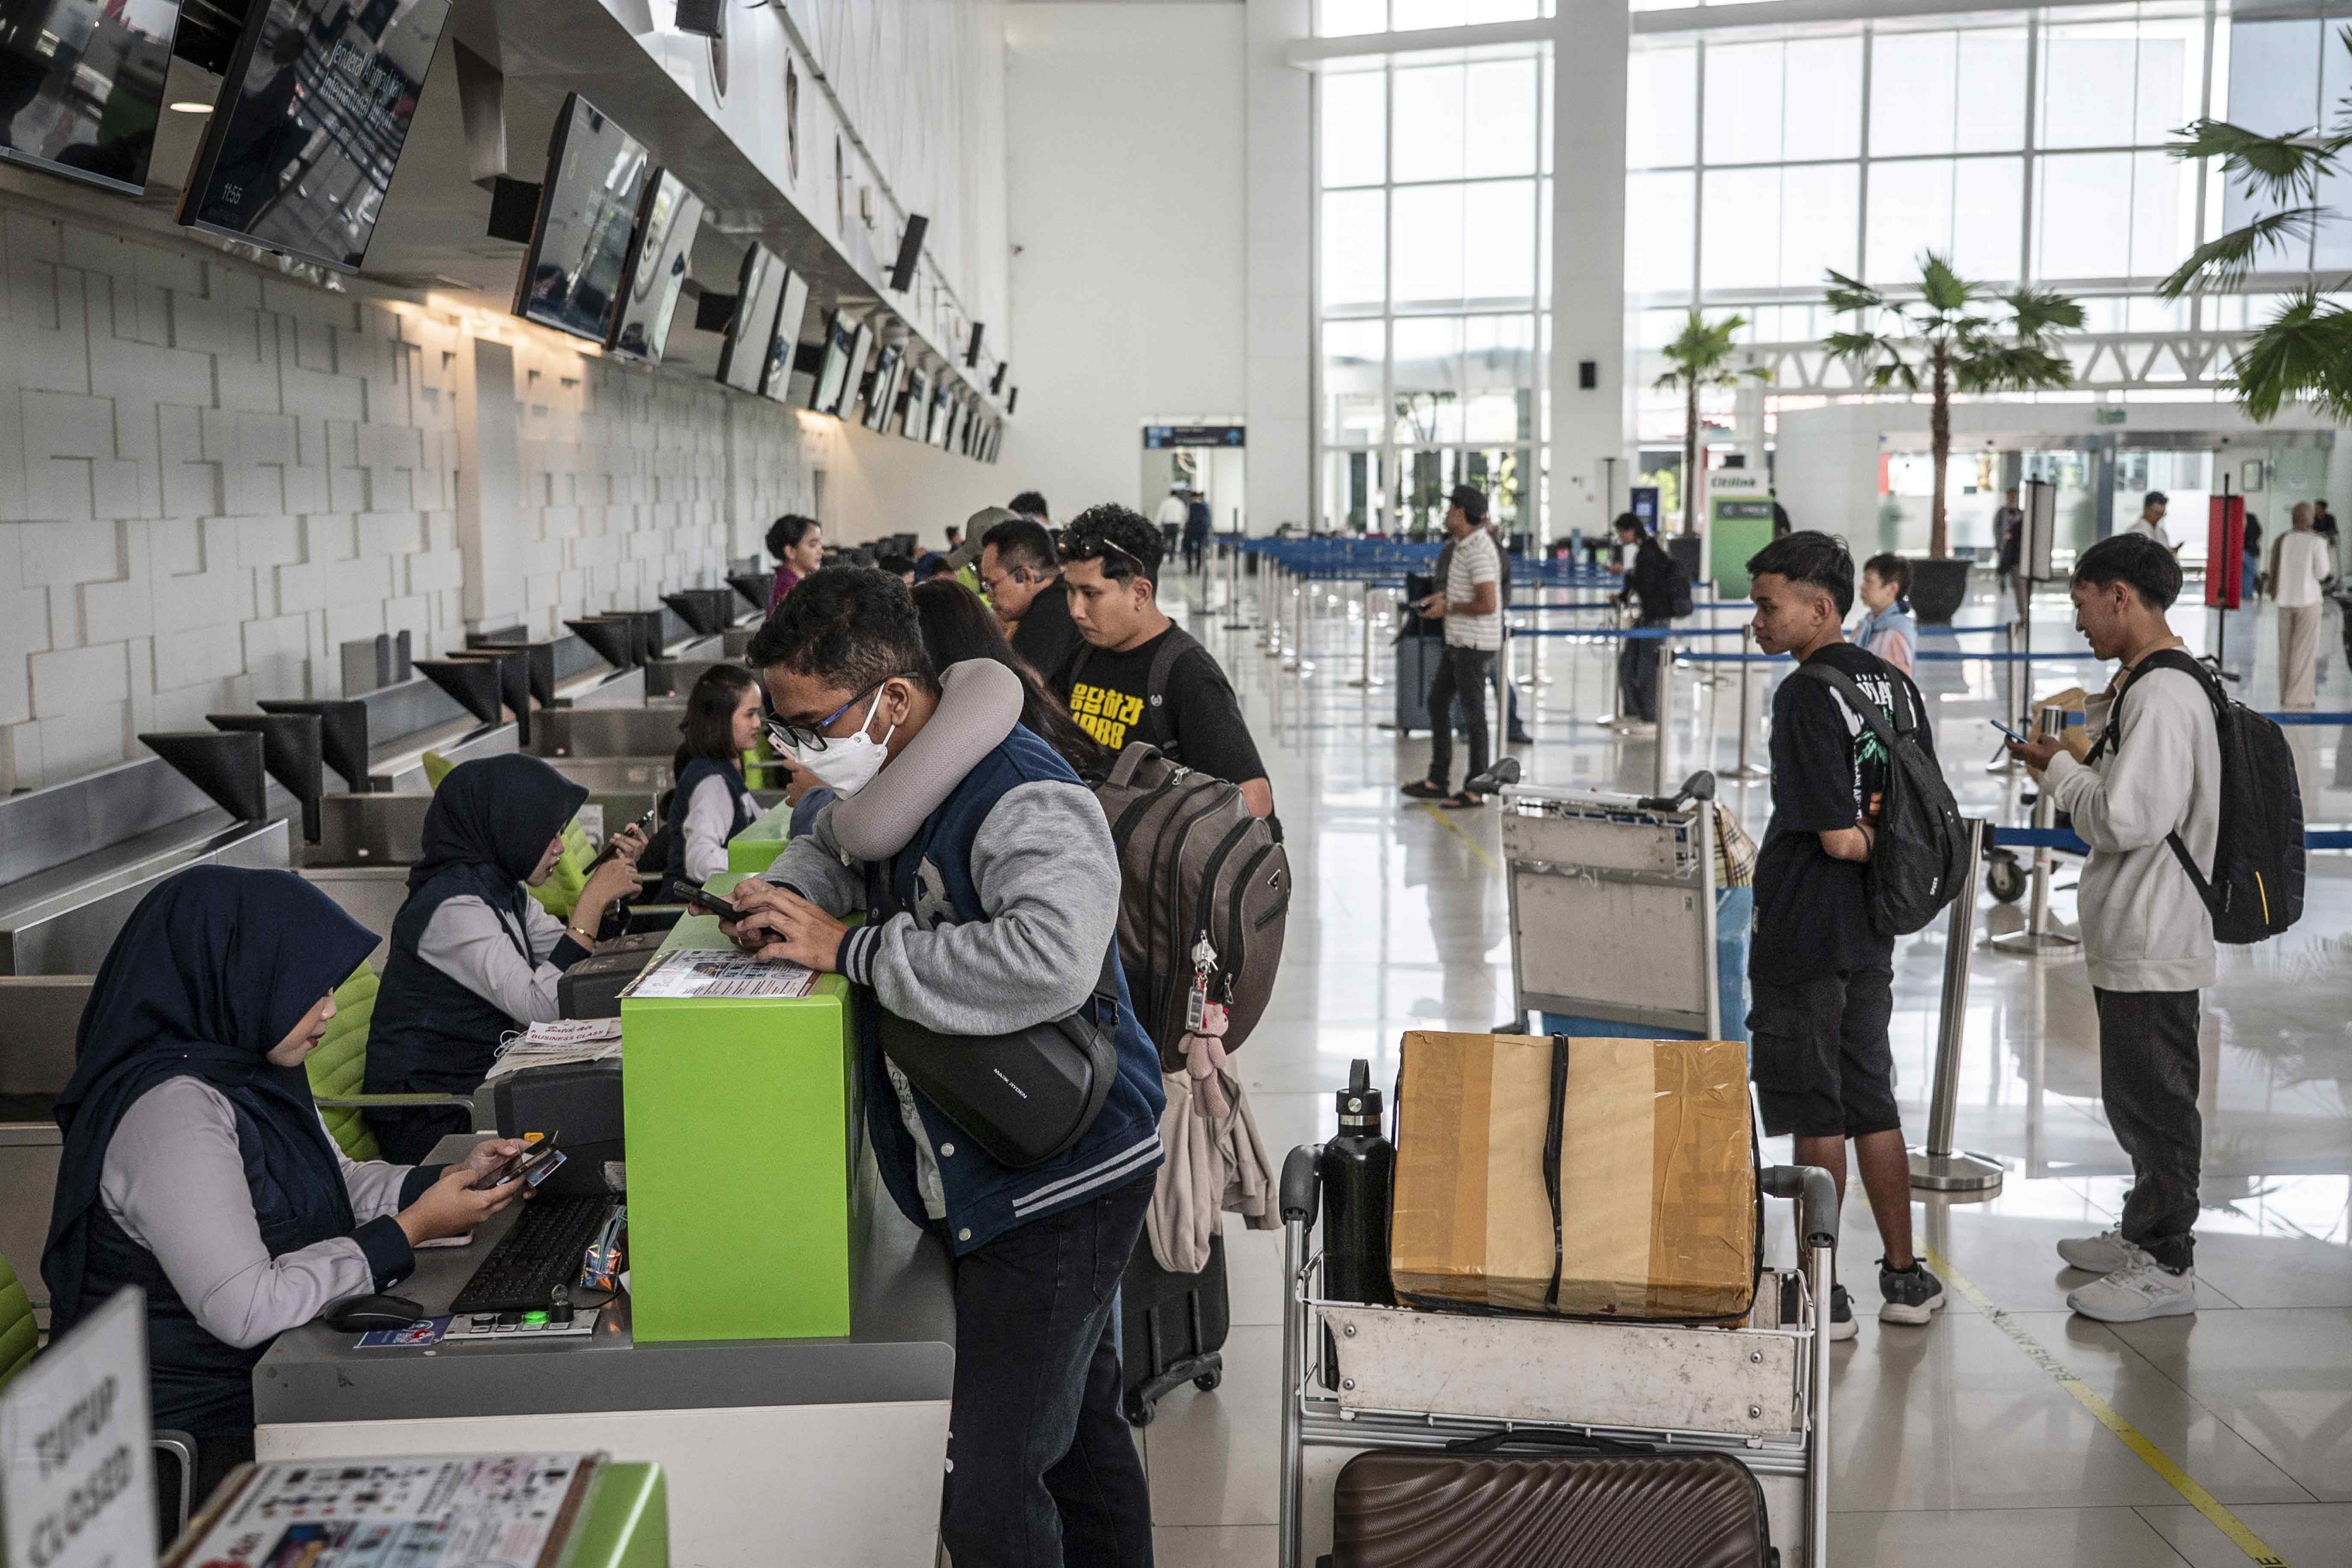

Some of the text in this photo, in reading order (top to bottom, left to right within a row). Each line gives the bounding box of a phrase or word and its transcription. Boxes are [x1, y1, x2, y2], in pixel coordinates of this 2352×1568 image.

[326, 39, 368, 77] Jenderal
[363, 58, 393, 93] Ahmad
[320, 72, 373, 118] International
[222, 183, 243, 204] 11:55
[1711, 477, 1756, 488] Citilink
[1070, 682, 1145, 726] 응답하라
[1072, 711, 1126, 750] 1988
[576, 1029, 604, 1039] CLASS
[993, 1068, 1028, 1099] MARK RYDEN
[28, 1445, 133, 1568] CLOSED
